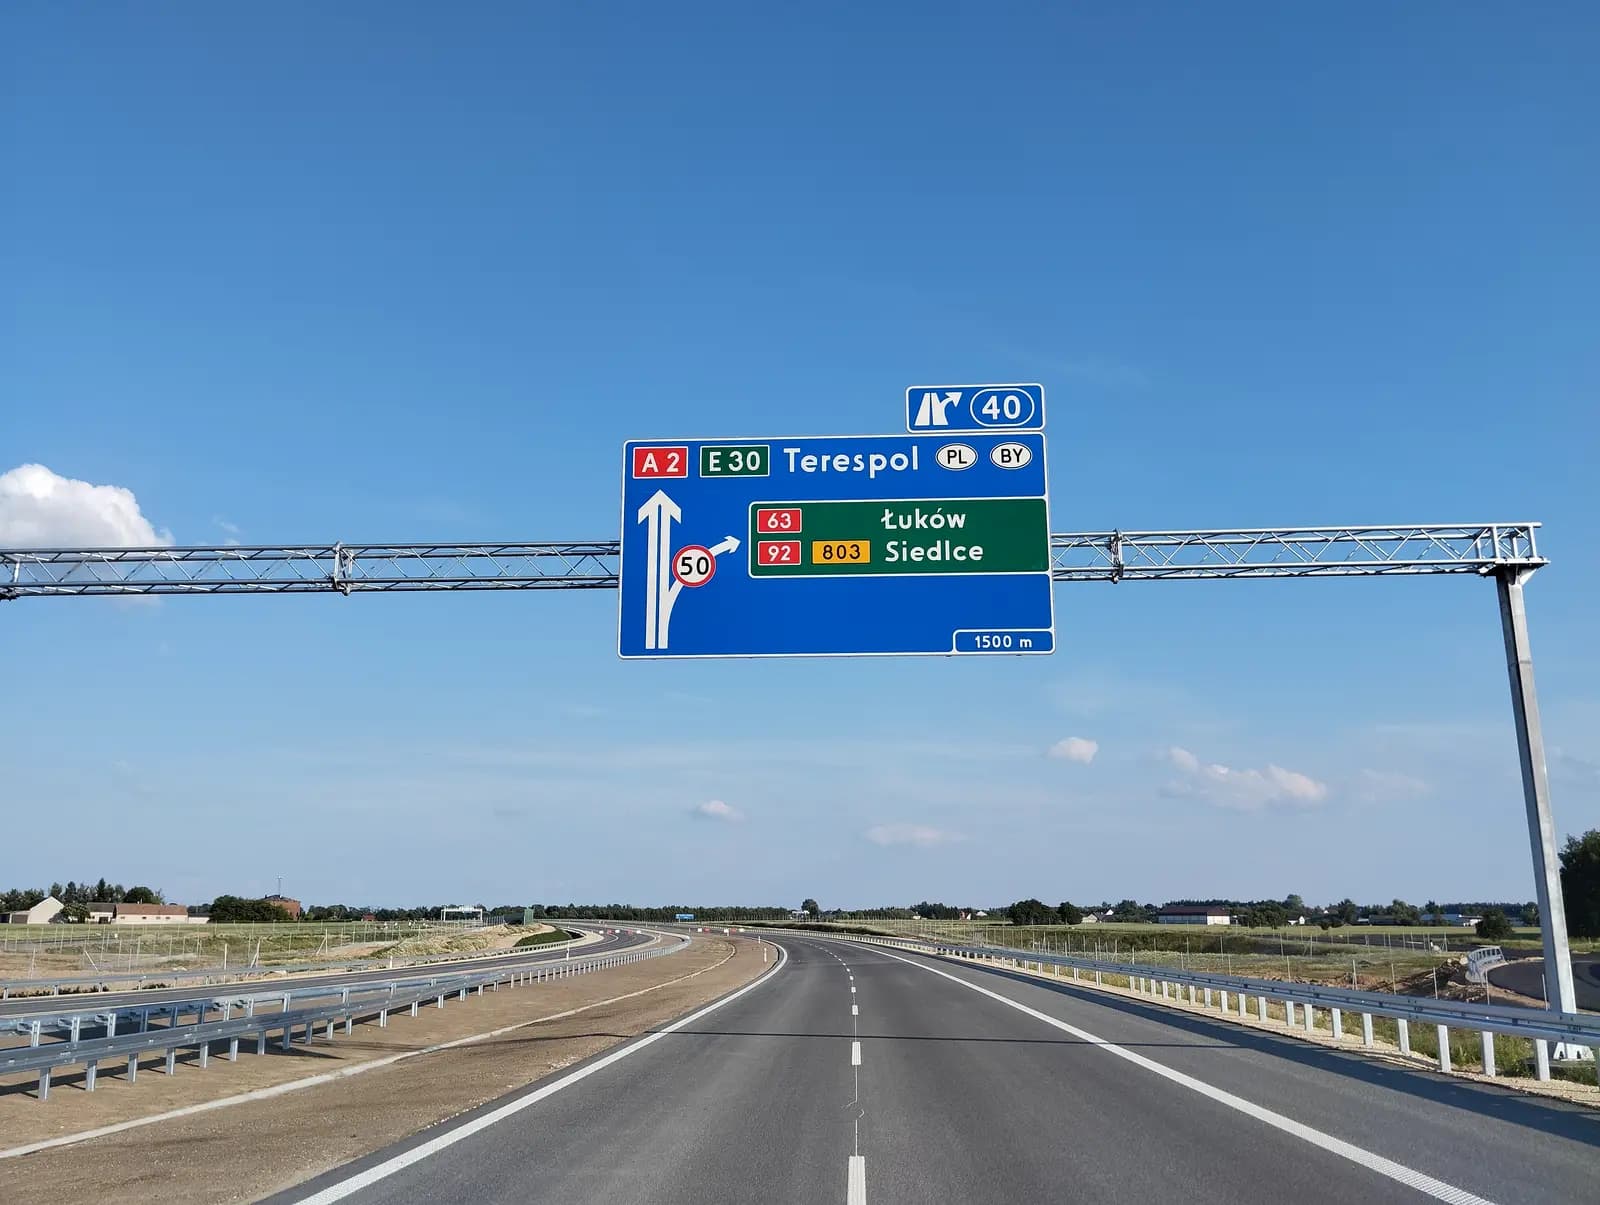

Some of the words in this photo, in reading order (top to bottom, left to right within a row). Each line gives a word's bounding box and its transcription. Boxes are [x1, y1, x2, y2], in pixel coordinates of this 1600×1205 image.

[981, 394, 1021, 420] 40
[641, 452, 659, 473] A
[666, 452, 680, 473] 2
[709, 451, 722, 472] E
[728, 450, 761, 472] 30
[783, 446, 919, 478] Terespol
[947, 449, 968, 465] PL
[999, 447, 1024, 463] BY
[767, 512, 792, 529] 63
[881, 507, 966, 530] Łuków
[768, 545, 791, 562] 92
[822, 543, 861, 561] 803
[884, 539, 984, 562] Siedlce
[680, 555, 711, 577] 50
[974, 635, 1012, 649] 1500
[1019, 638, 1033, 648] m
